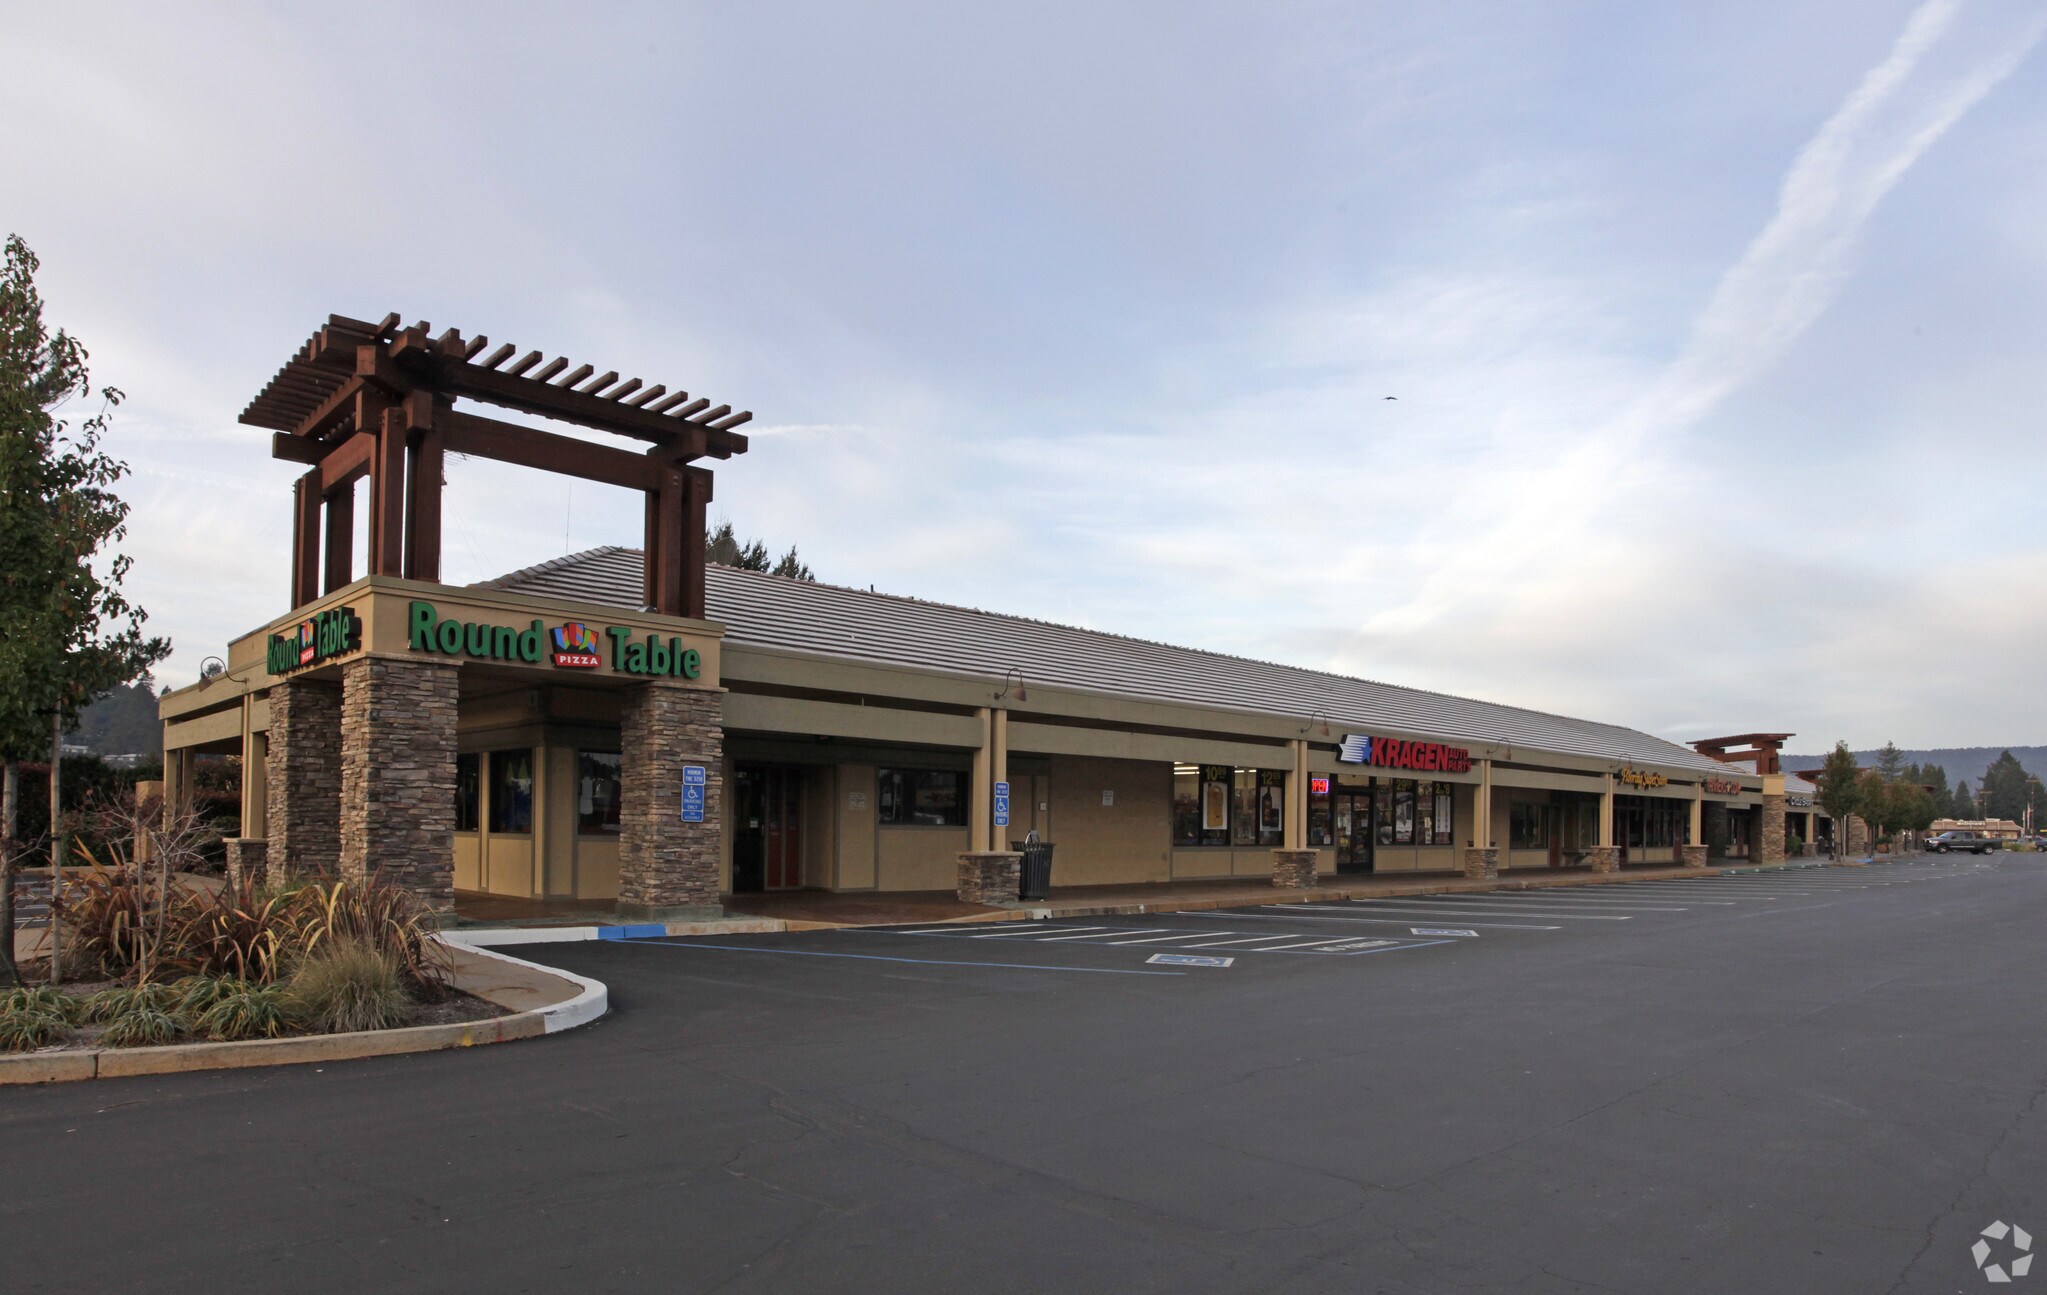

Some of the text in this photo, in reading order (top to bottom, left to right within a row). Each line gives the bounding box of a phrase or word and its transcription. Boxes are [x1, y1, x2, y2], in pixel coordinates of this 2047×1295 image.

[267, 604, 354, 676] Round Table
[410, 601, 701, 679] Round Table
[559, 655, 599, 665] PIZZA
[1371, 736, 1449, 771] KRAGEN
[1449, 748, 1468, 760] AUTO
[1448, 760, 1472, 772] PARTS
